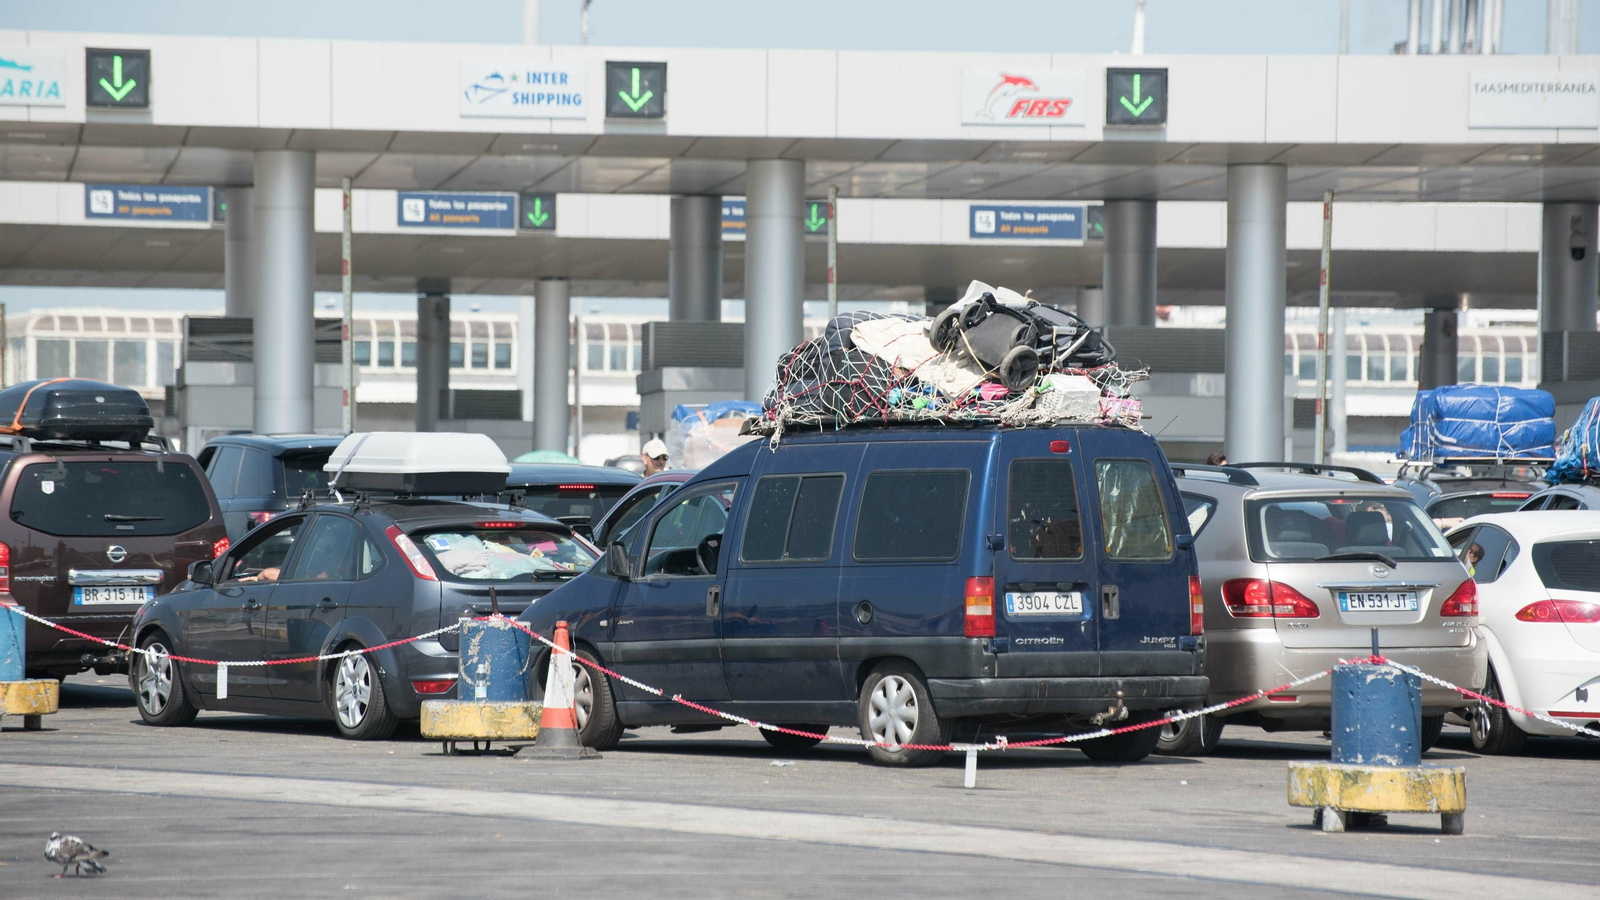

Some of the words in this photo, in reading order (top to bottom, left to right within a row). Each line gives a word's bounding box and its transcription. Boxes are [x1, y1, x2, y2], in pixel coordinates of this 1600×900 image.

[526, 71, 568, 85] INTER
[0, 78, 61, 98] ARIA
[1474, 81, 1597, 95] TRASMEDITERRANEA
[512, 92, 582, 106] SHIPPING
[1006, 97, 1072, 118] FRS
[84, 587, 146, 602] BR-315-TA
[1349, 593, 1407, 609] EN-531-JT
[1016, 595, 1050, 611] 3904
[1054, 594, 1079, 610] CZL
[1015, 636, 1065, 645] CITROËN
[1139, 635, 1176, 644] JUMPY
